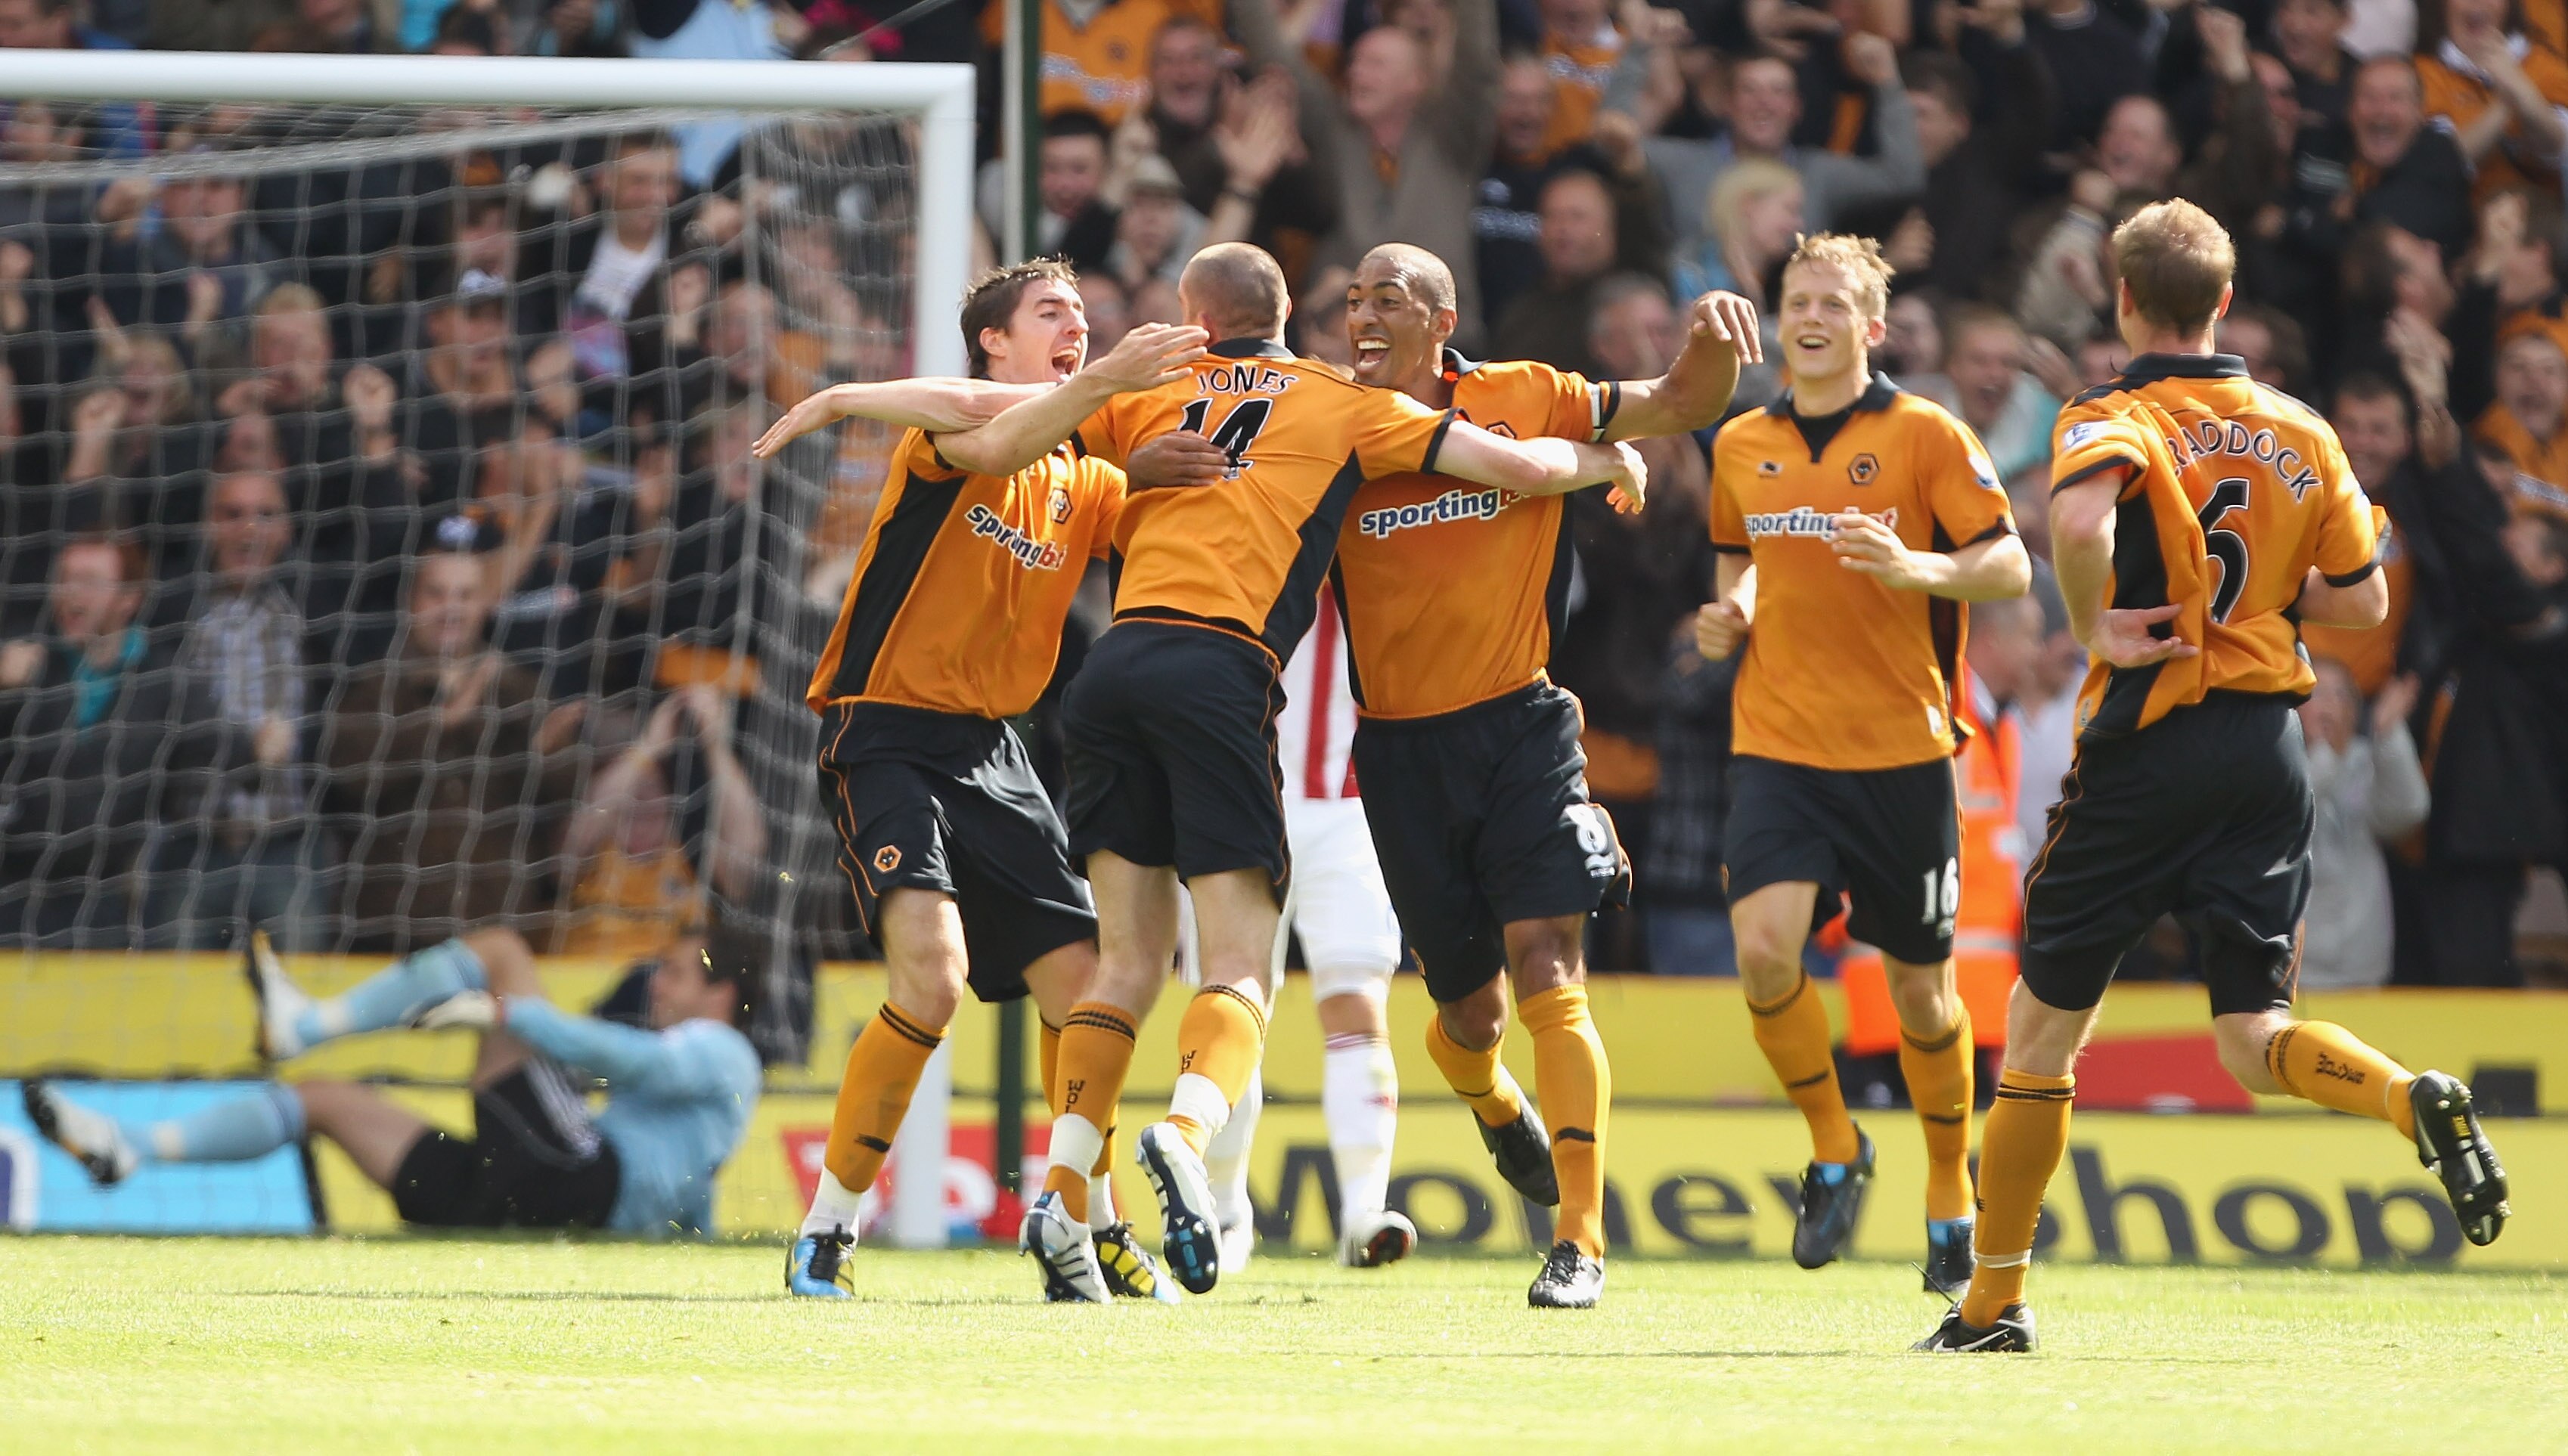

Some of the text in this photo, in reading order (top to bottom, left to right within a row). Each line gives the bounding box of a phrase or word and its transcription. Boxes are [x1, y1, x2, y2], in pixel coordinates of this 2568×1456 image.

[1197, 363, 1299, 396] JONES
[1177, 397, 1274, 470] 14
[1921, 855, 1960, 925] 16
[1969, 1142, 2466, 1265] hop
